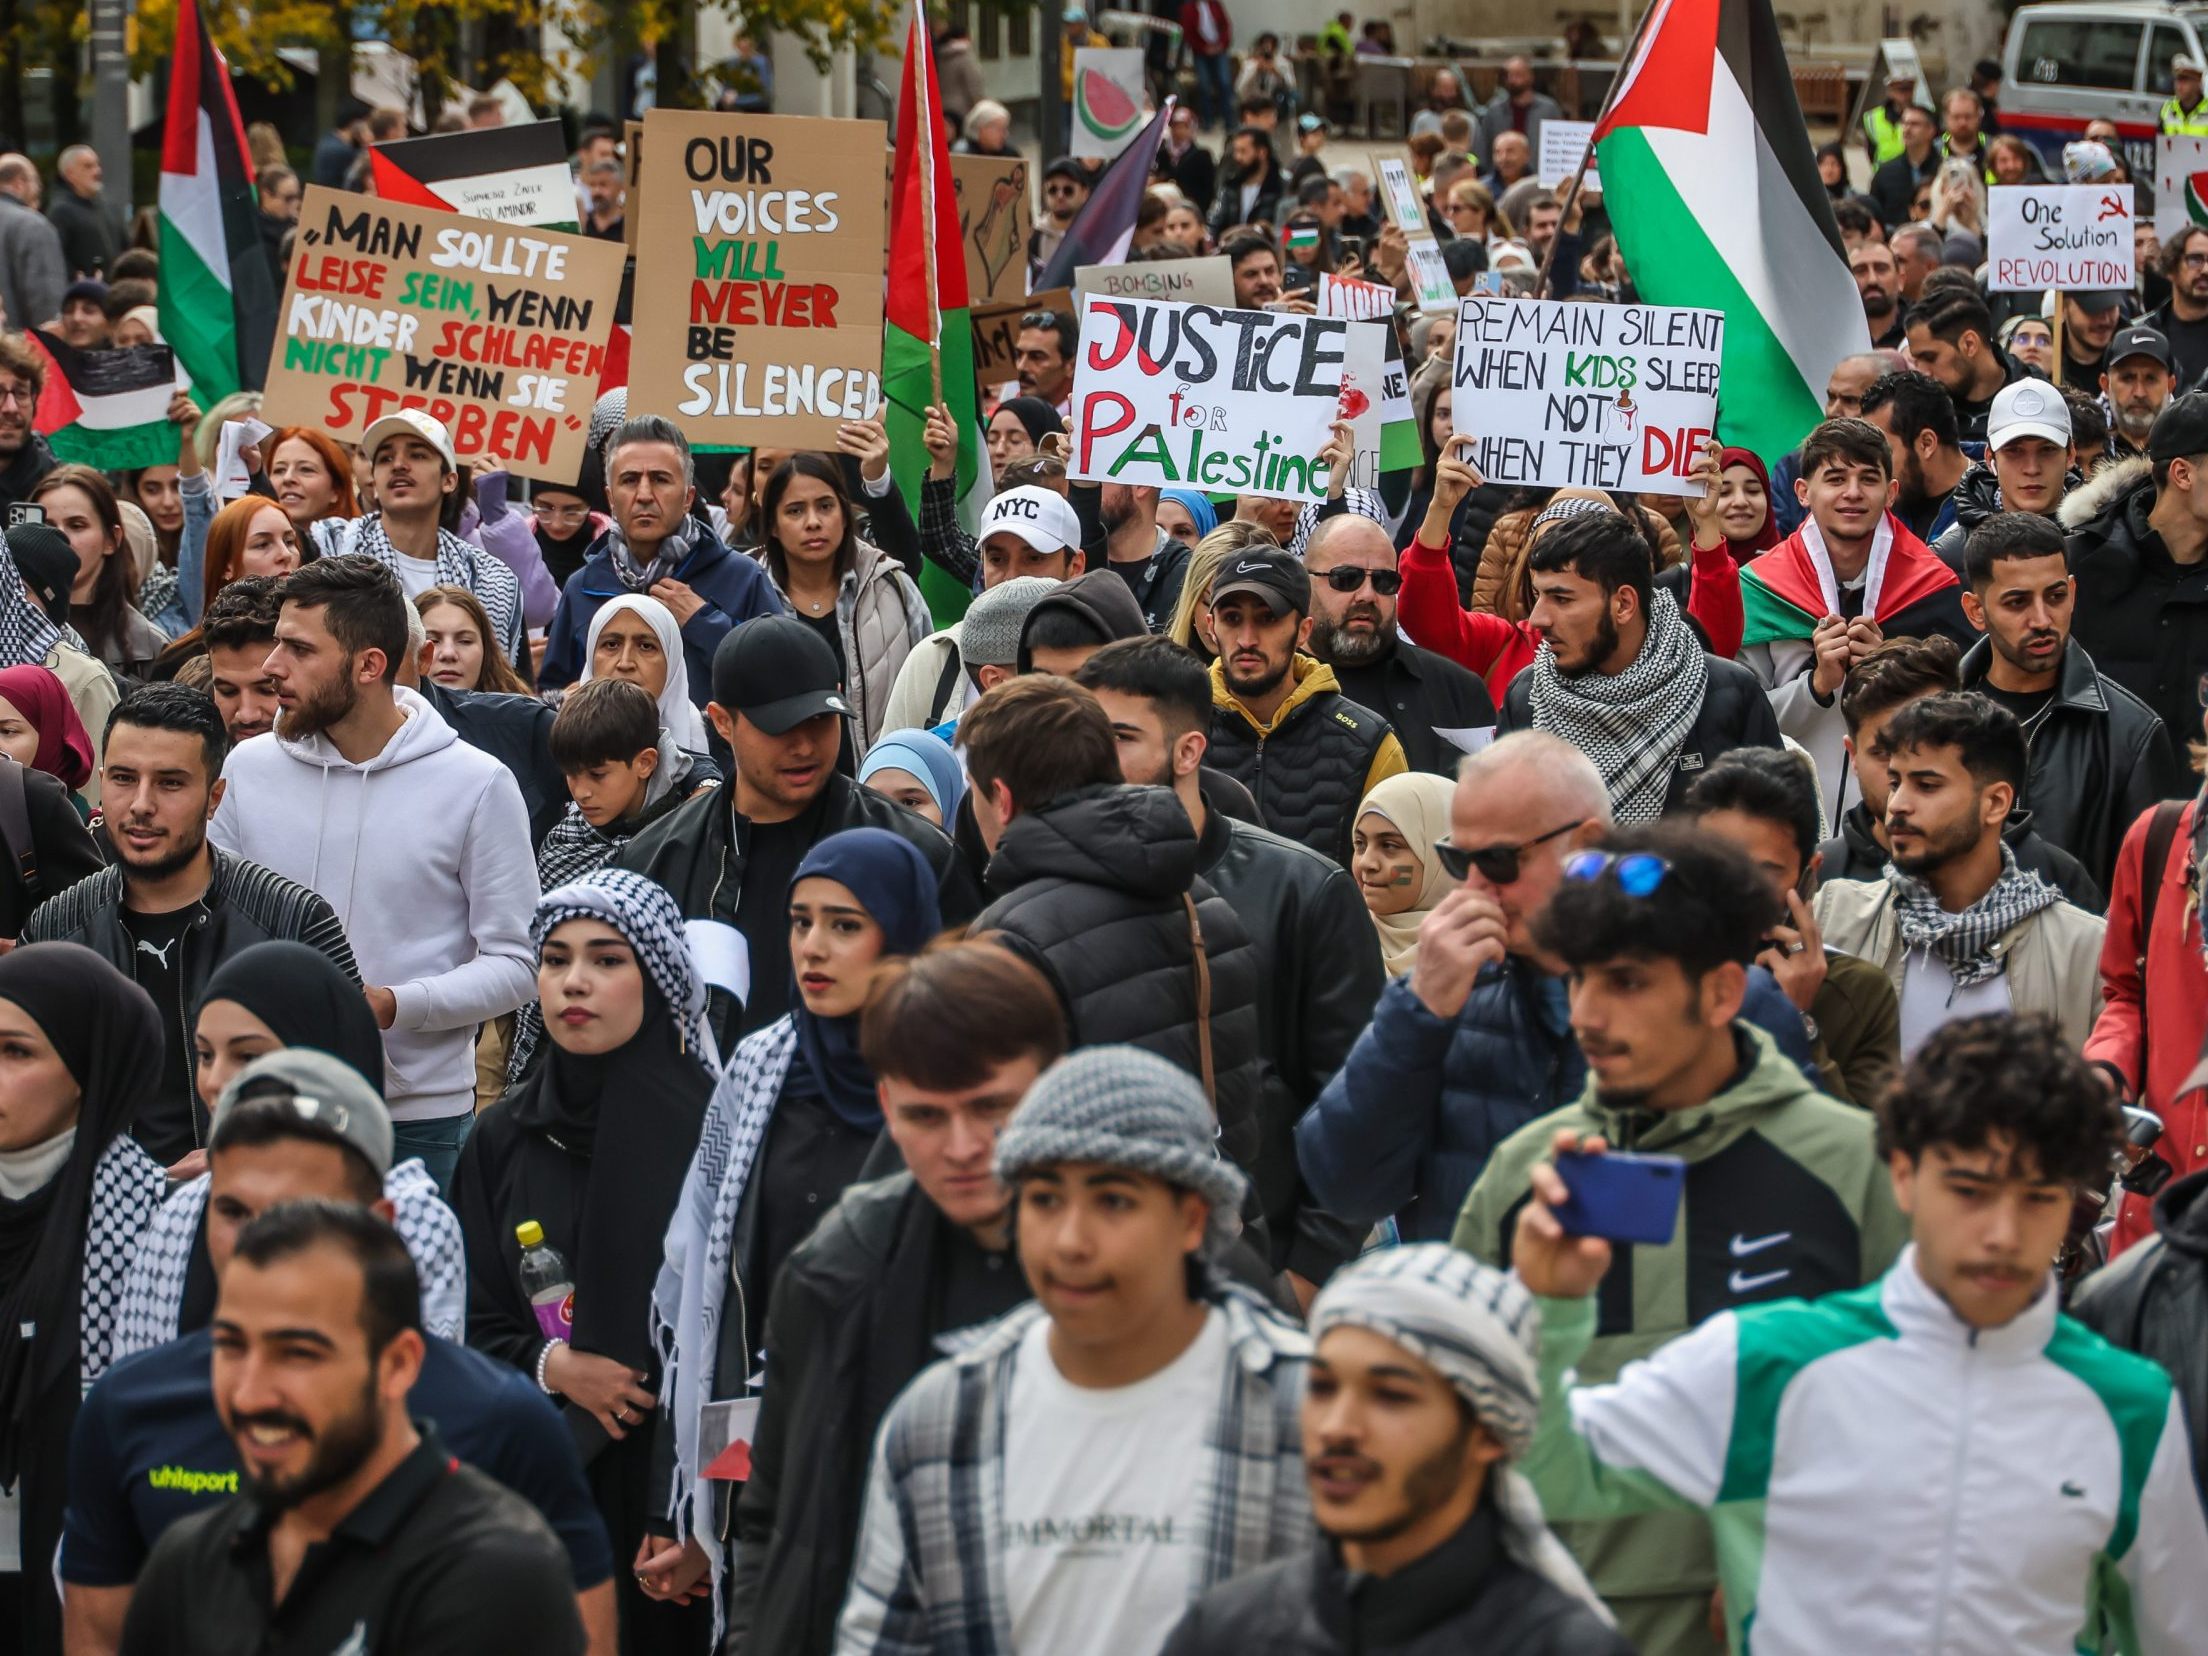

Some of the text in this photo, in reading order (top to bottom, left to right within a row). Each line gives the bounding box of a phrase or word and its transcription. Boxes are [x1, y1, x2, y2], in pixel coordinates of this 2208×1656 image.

[684, 135, 774, 184] OUR
[690, 189, 839, 235] VOICES
[2021, 197, 2062, 224] One
[430, 228, 569, 280] SOLLTE
[692, 236, 785, 281] WILL
[2033, 225, 2117, 251] Solution
[295, 253, 594, 332] LEISE SEIN, WENN
[1104, 272, 1194, 295] BOMBING
[1998, 258, 2127, 287] REVOLUTION
[690, 279, 839, 328] NEVER
[1459, 300, 1724, 352] REMAIN SILENT
[287, 293, 606, 377] KINDER SCHLAFEN
[686, 326, 736, 361] BE
[284, 337, 568, 413] NICHT WENN SIE
[678, 362, 881, 421] SILENCED
[1455, 346, 1720, 399] WHEN KIDS SLEEP,
[1545, 393, 1614, 433] NOT
[1459, 425, 1712, 488] WHEN THEY DIE
[993, 498, 1040, 520] NYC
[1335, 712, 1359, 729] BOSS
[149, 1464, 239, 1496] uhlsport
